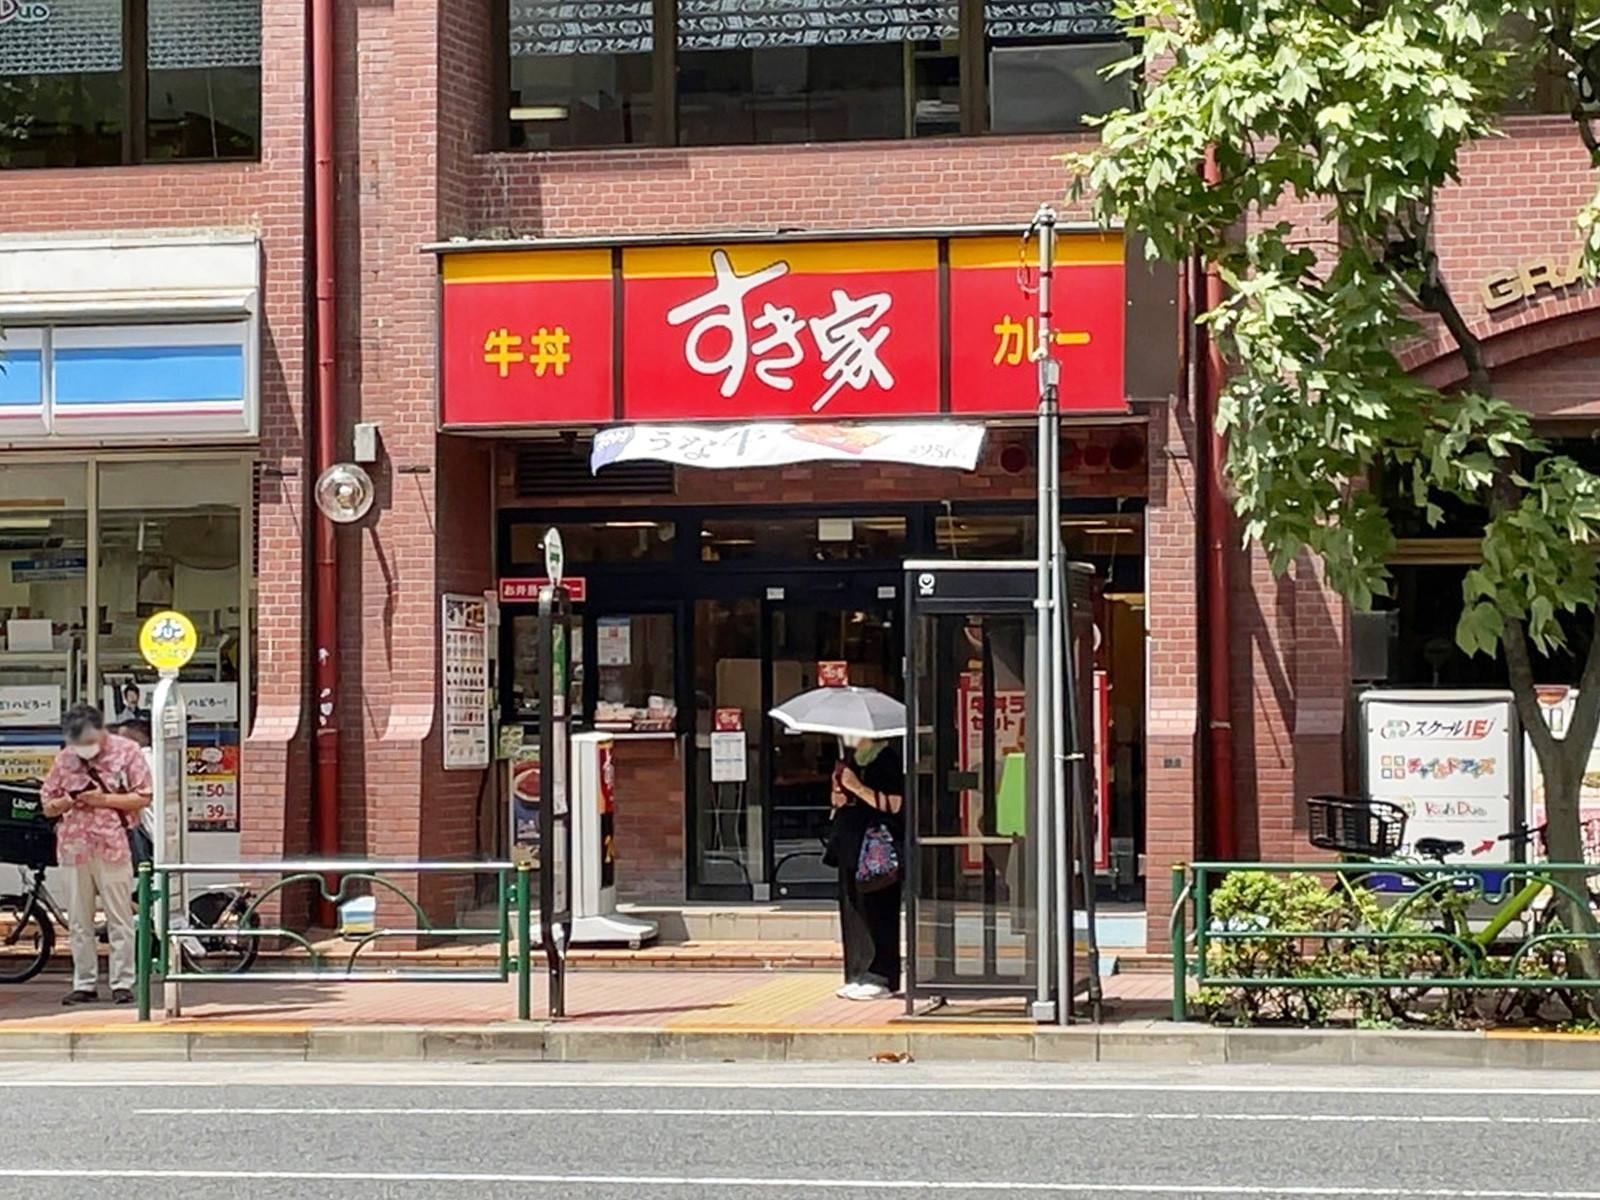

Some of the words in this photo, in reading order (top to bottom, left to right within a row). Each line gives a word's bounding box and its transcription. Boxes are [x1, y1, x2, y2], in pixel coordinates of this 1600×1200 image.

[484, 327, 571, 377] 牛丼
[667, 248, 896, 412] すき家
[993, 315, 1091, 365] カレー
